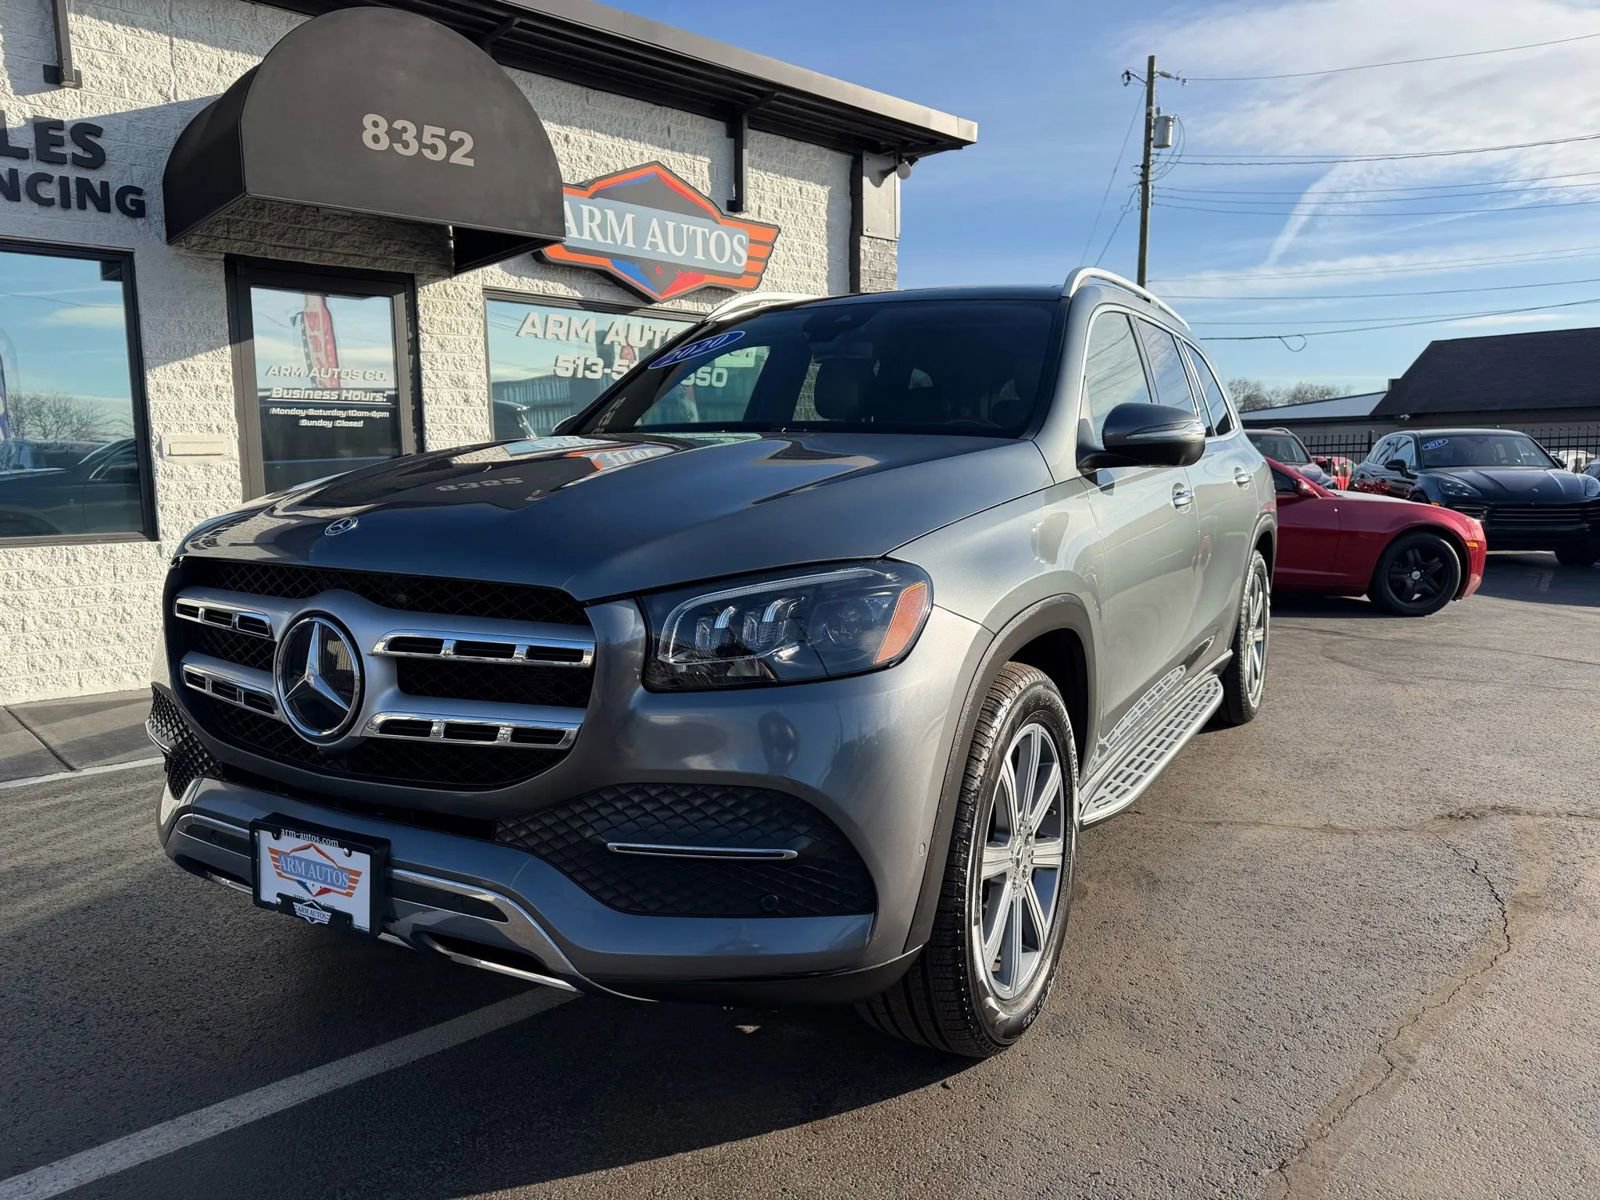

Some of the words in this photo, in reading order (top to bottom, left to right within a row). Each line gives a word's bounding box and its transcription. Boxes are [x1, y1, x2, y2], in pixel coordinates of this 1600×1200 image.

[362, 113, 475, 167] 8352
[564, 201, 636, 248] ARM
[643, 218, 748, 267] AUTOS
[516, 311, 597, 344] ARM
[603, 318, 683, 350] AUT
[266, 366, 303, 378] ARM
[308, 367, 360, 380] AUTOS
[271, 387, 339, 400] Business
[341, 389, 388, 401] Hours:
[299, 419, 333, 428] Sunday
[334, 420, 364, 428] Closed
[281, 828, 339, 847] arm-autos.com
[279, 855, 306, 876] ARM
[308, 864, 350, 887] AUTOS
